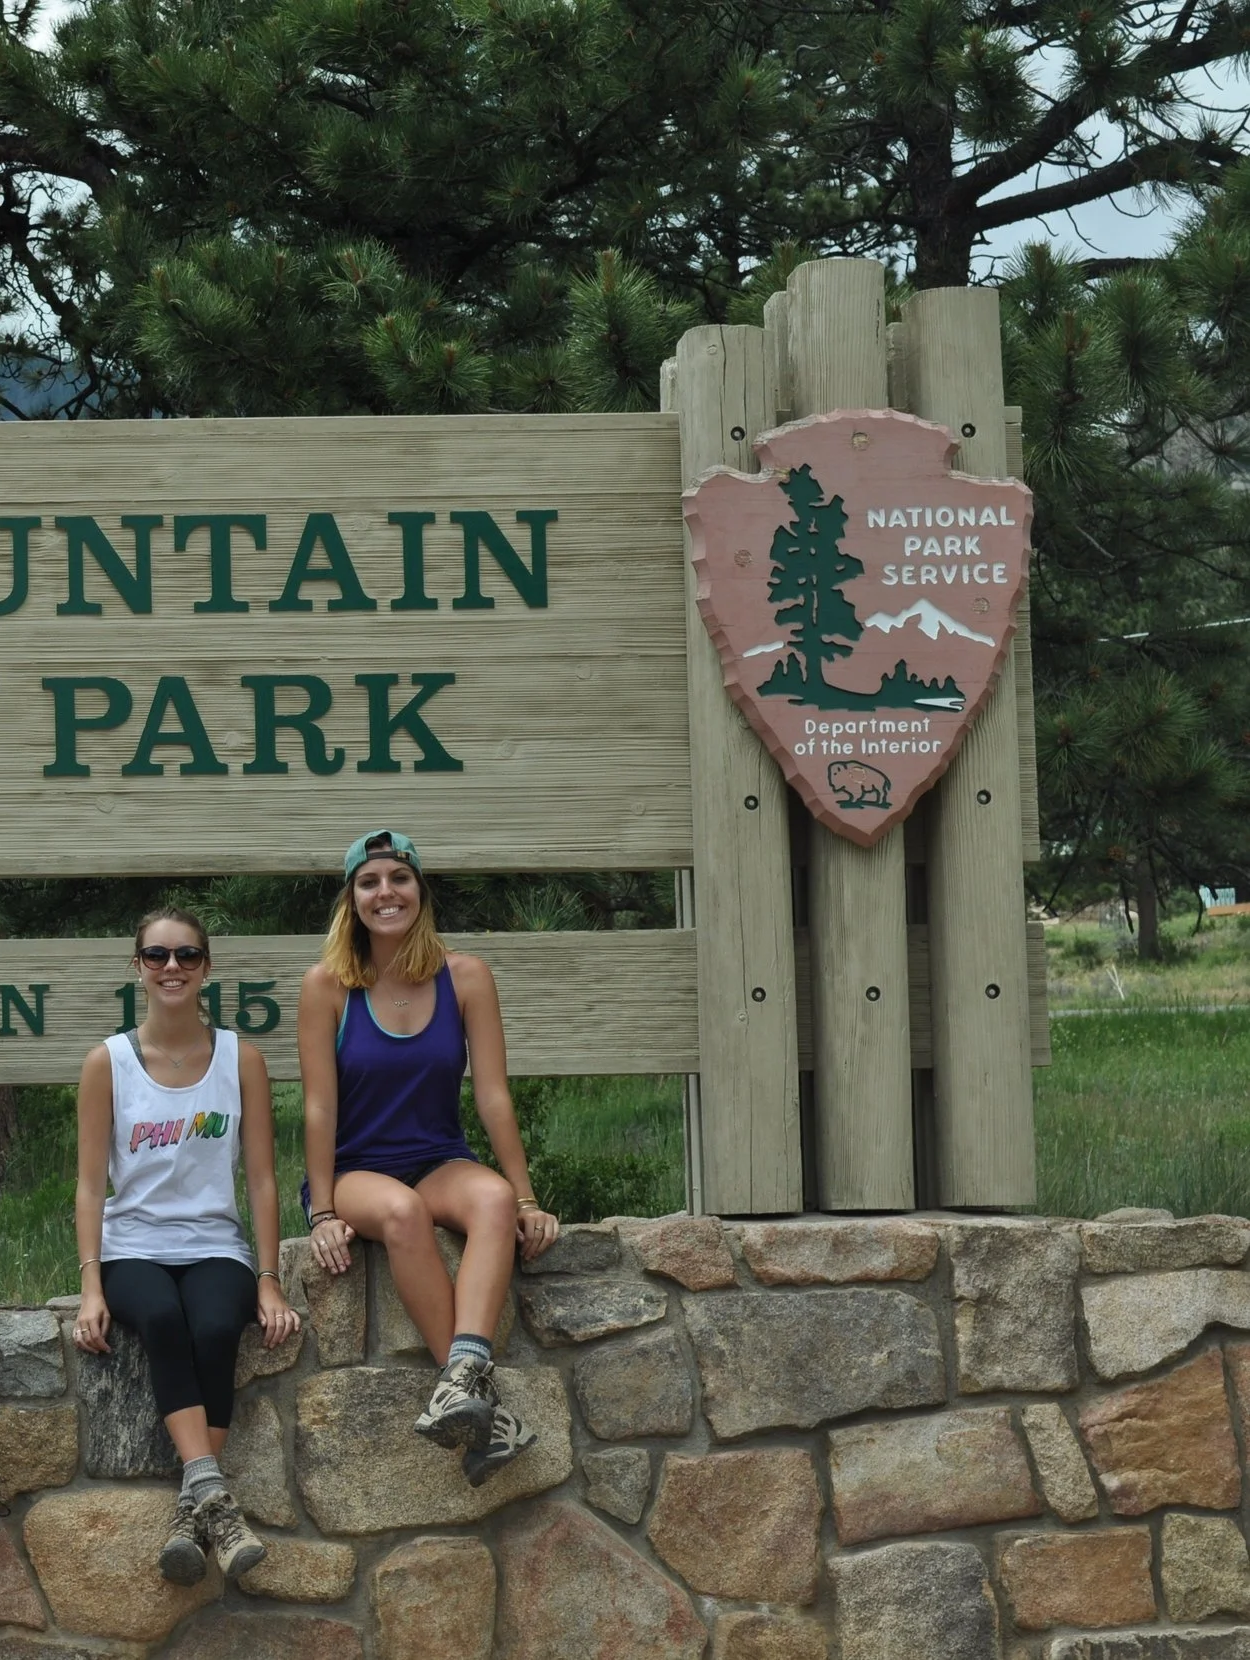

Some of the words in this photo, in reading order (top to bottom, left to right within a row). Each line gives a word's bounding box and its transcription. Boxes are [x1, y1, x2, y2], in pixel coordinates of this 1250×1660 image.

[866, 505, 1016, 529] NATIONAL
[903, 534, 981, 557] PARK
[881, 562, 1008, 586] SERVICE
[41, 672, 465, 778] PARK
[804, 716, 930, 738] Department
[793, 739, 817, 756] of
[821, 737, 854, 755] the
[860, 736, 942, 754] Interior
[114, 980, 282, 1035] 115
[129, 1118, 186, 1154] PHI
[186, 1111, 230, 1141] MU
